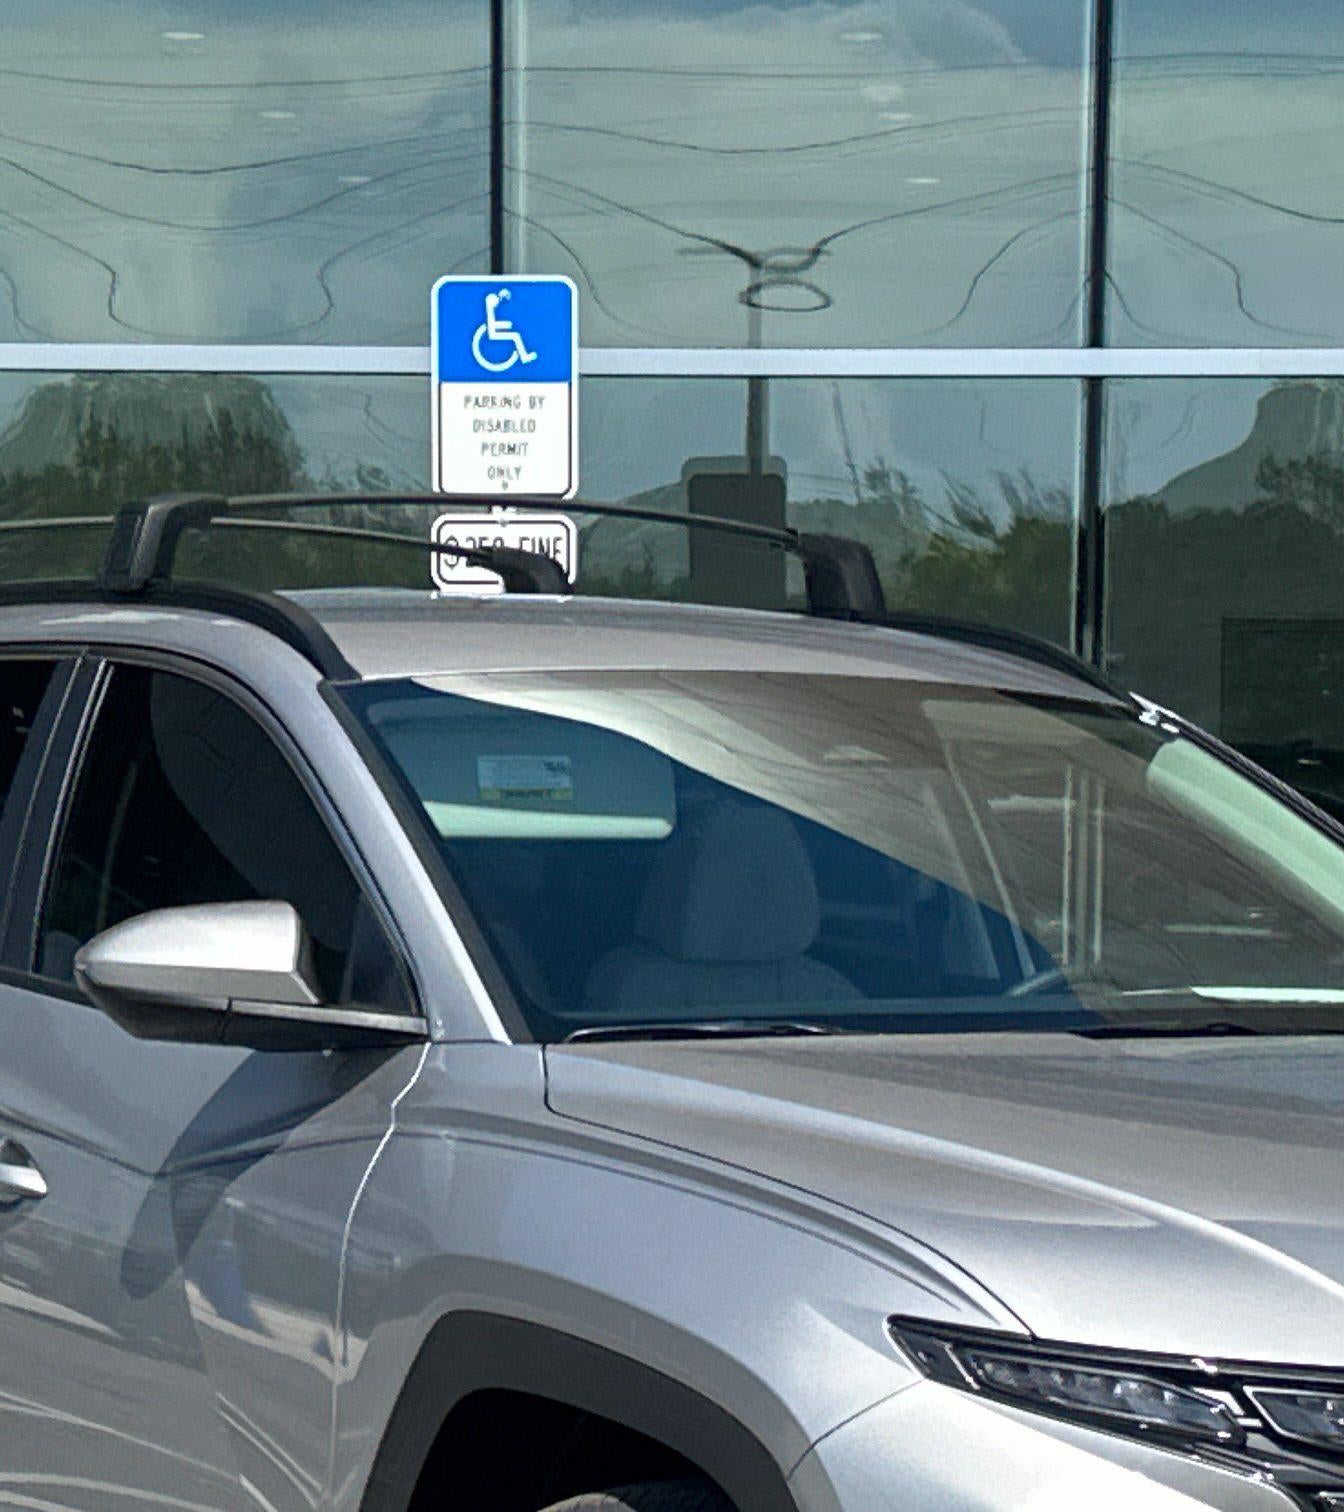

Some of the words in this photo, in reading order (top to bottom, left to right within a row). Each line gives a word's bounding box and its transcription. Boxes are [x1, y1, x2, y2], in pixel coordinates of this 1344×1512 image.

[463, 394, 521, 409] PARKING
[528, 394, 545, 410] BY
[472, 418, 536, 434] DISABLED
[480, 441, 529, 457] PERMIT
[487, 465, 522, 480] ONLY
